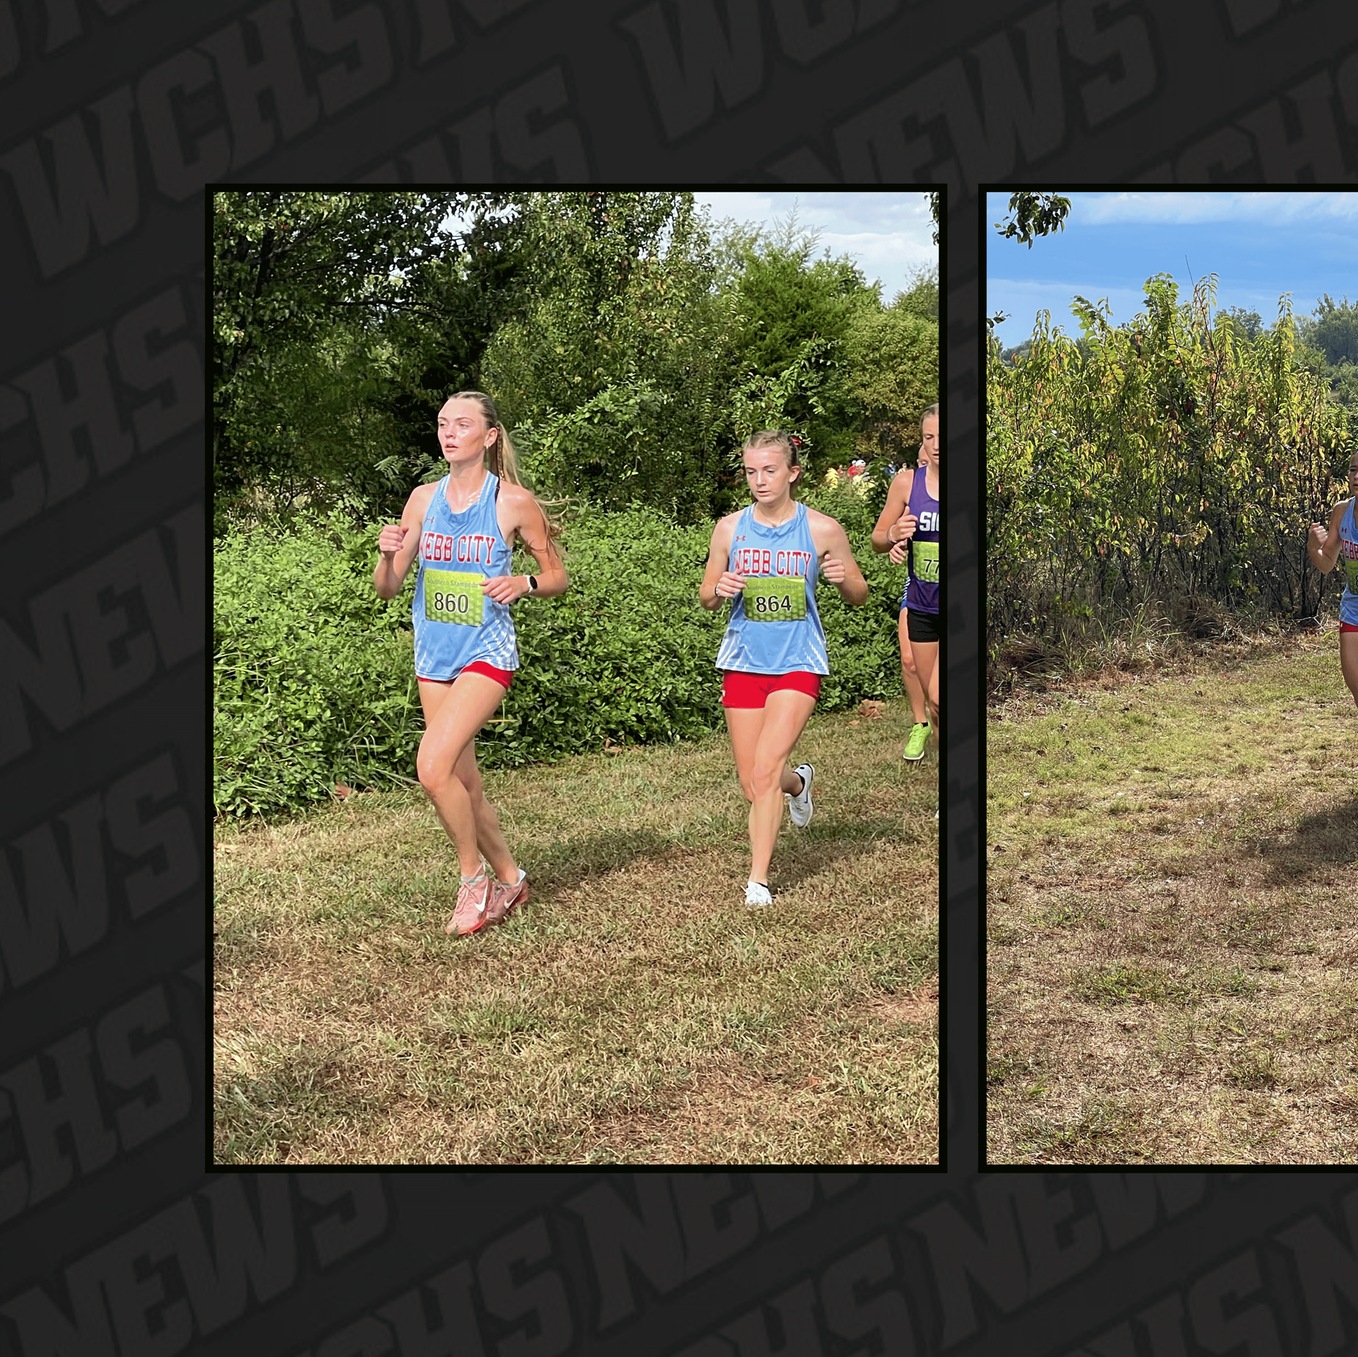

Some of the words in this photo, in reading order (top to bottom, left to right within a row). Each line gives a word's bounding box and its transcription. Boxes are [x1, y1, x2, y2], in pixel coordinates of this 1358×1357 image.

[456, 535, 496, 566] CITY
[776, 550, 812, 577] CITY
[434, 591, 470, 614] 860
[756, 594, 793, 614] 864
